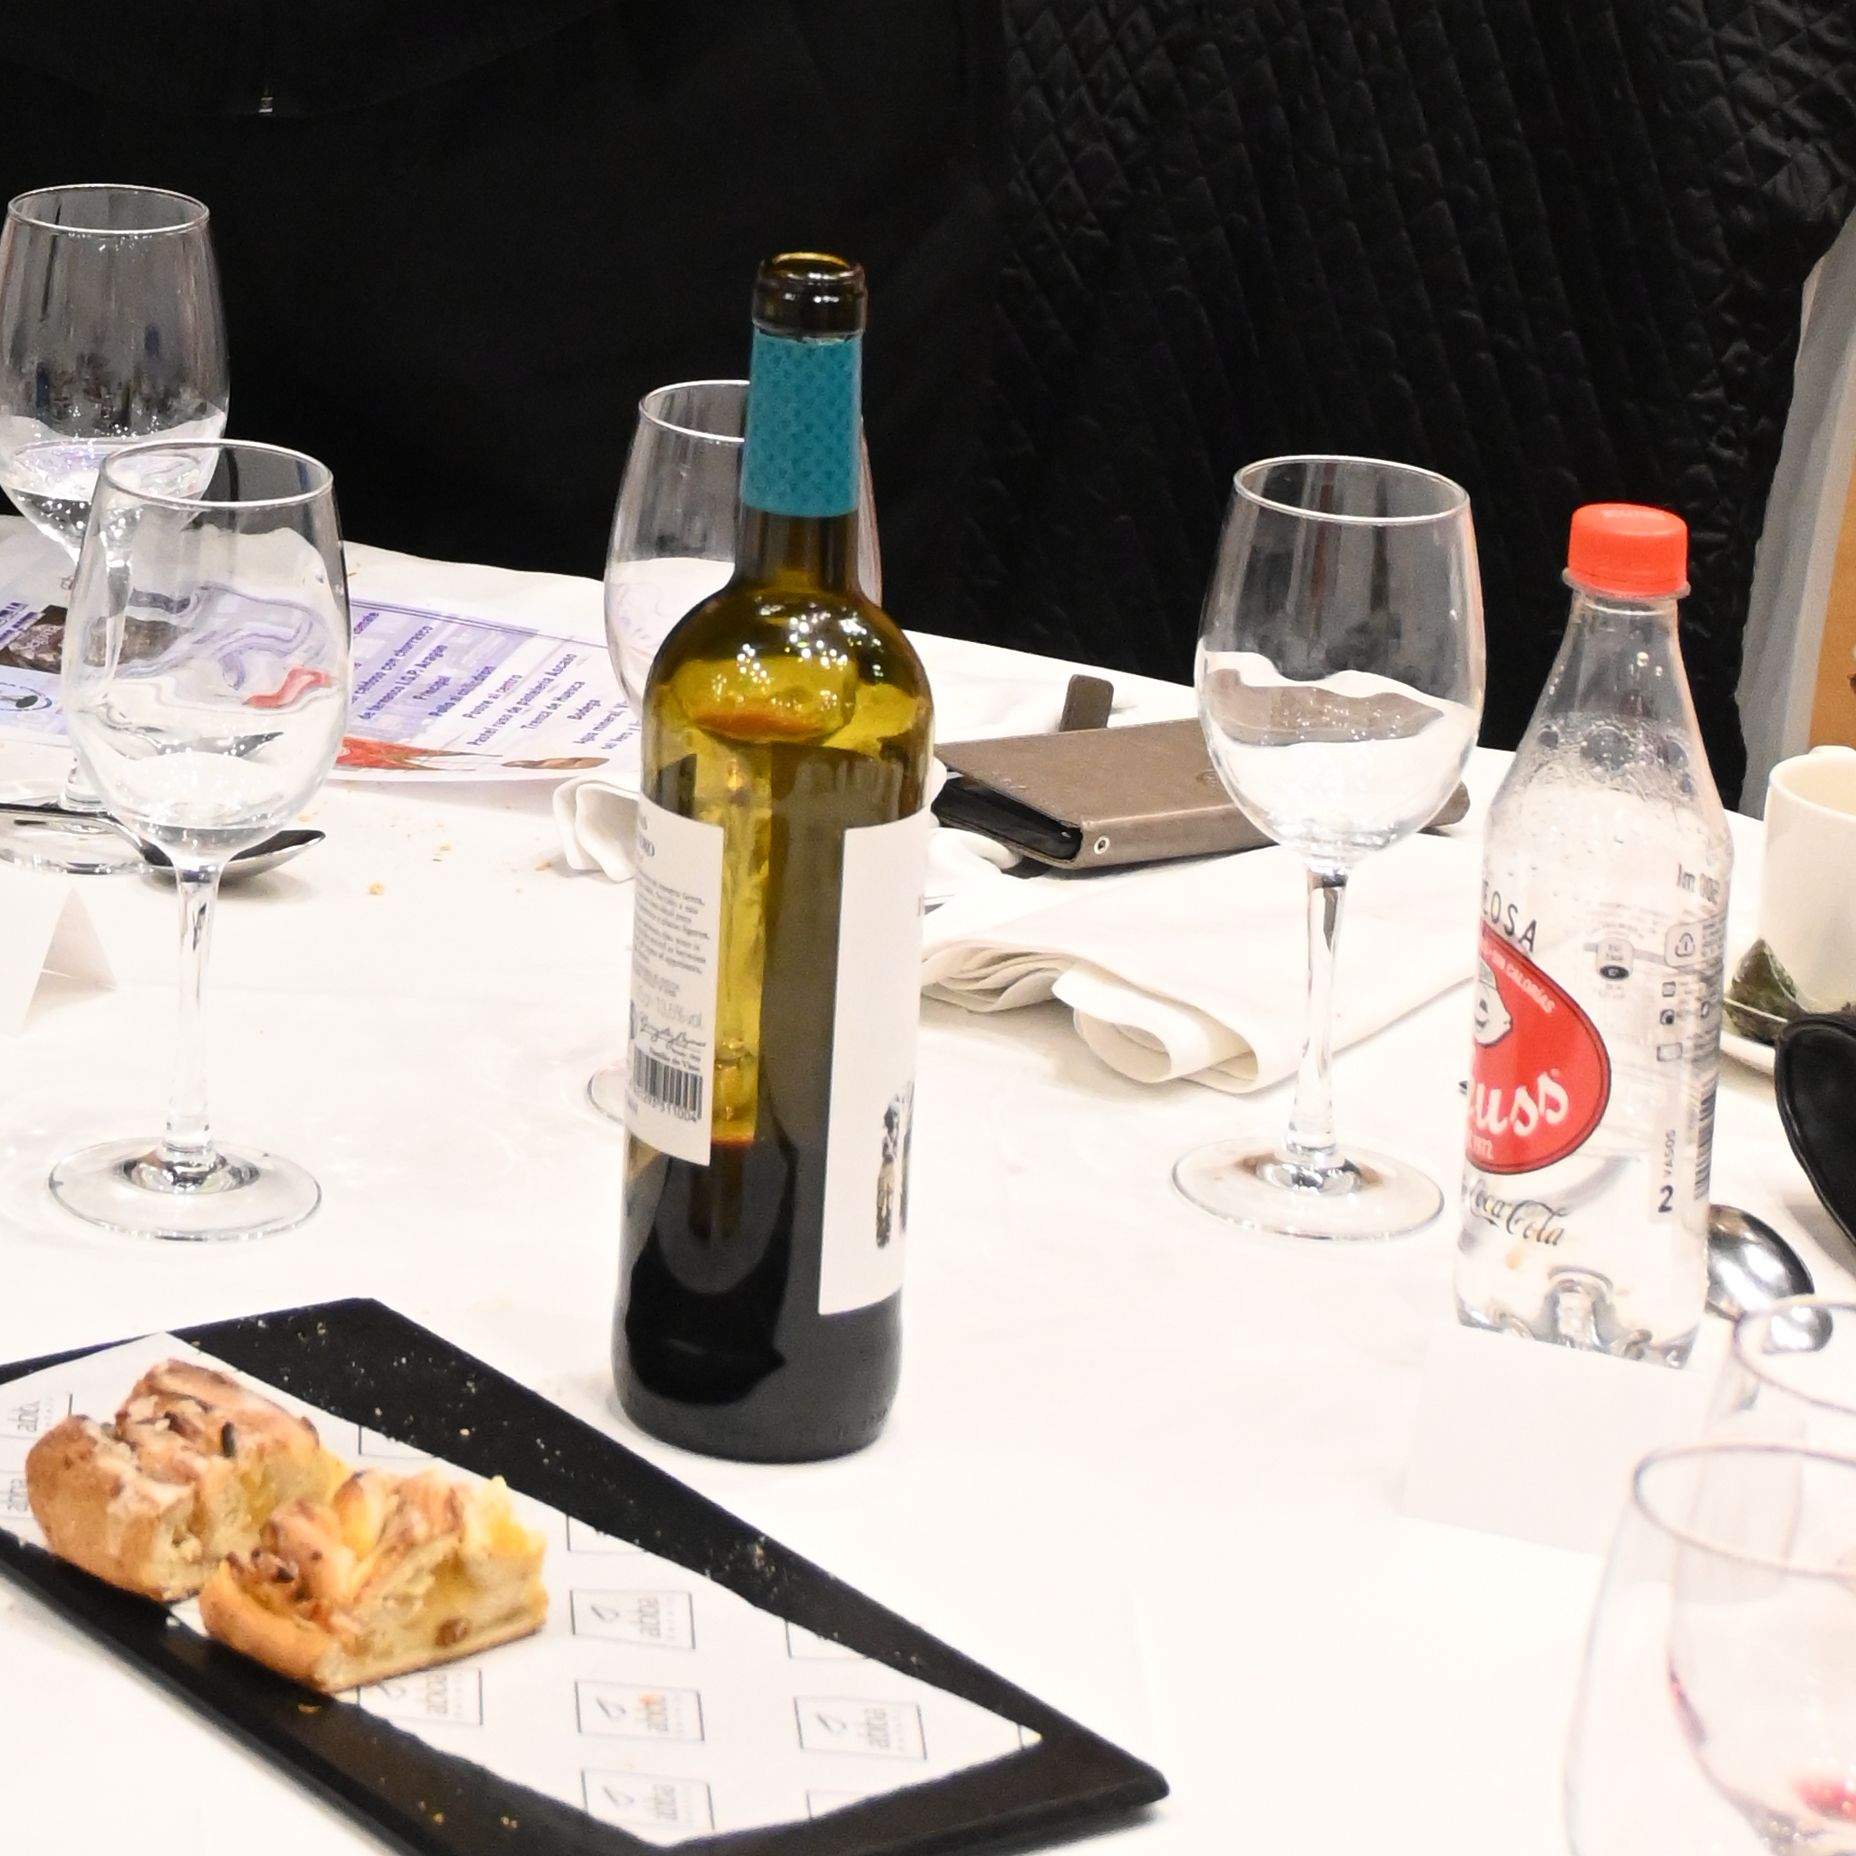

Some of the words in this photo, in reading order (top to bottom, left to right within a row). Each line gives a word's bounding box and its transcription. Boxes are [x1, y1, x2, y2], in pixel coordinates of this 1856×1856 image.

[545, 653, 578, 677] Ascaso
[520, 710, 553, 730] Trenza
[553, 681, 586, 702] Huesca
[567, 699, 601, 721] Bodega
[1658, 1184, 1674, 1214] 2
